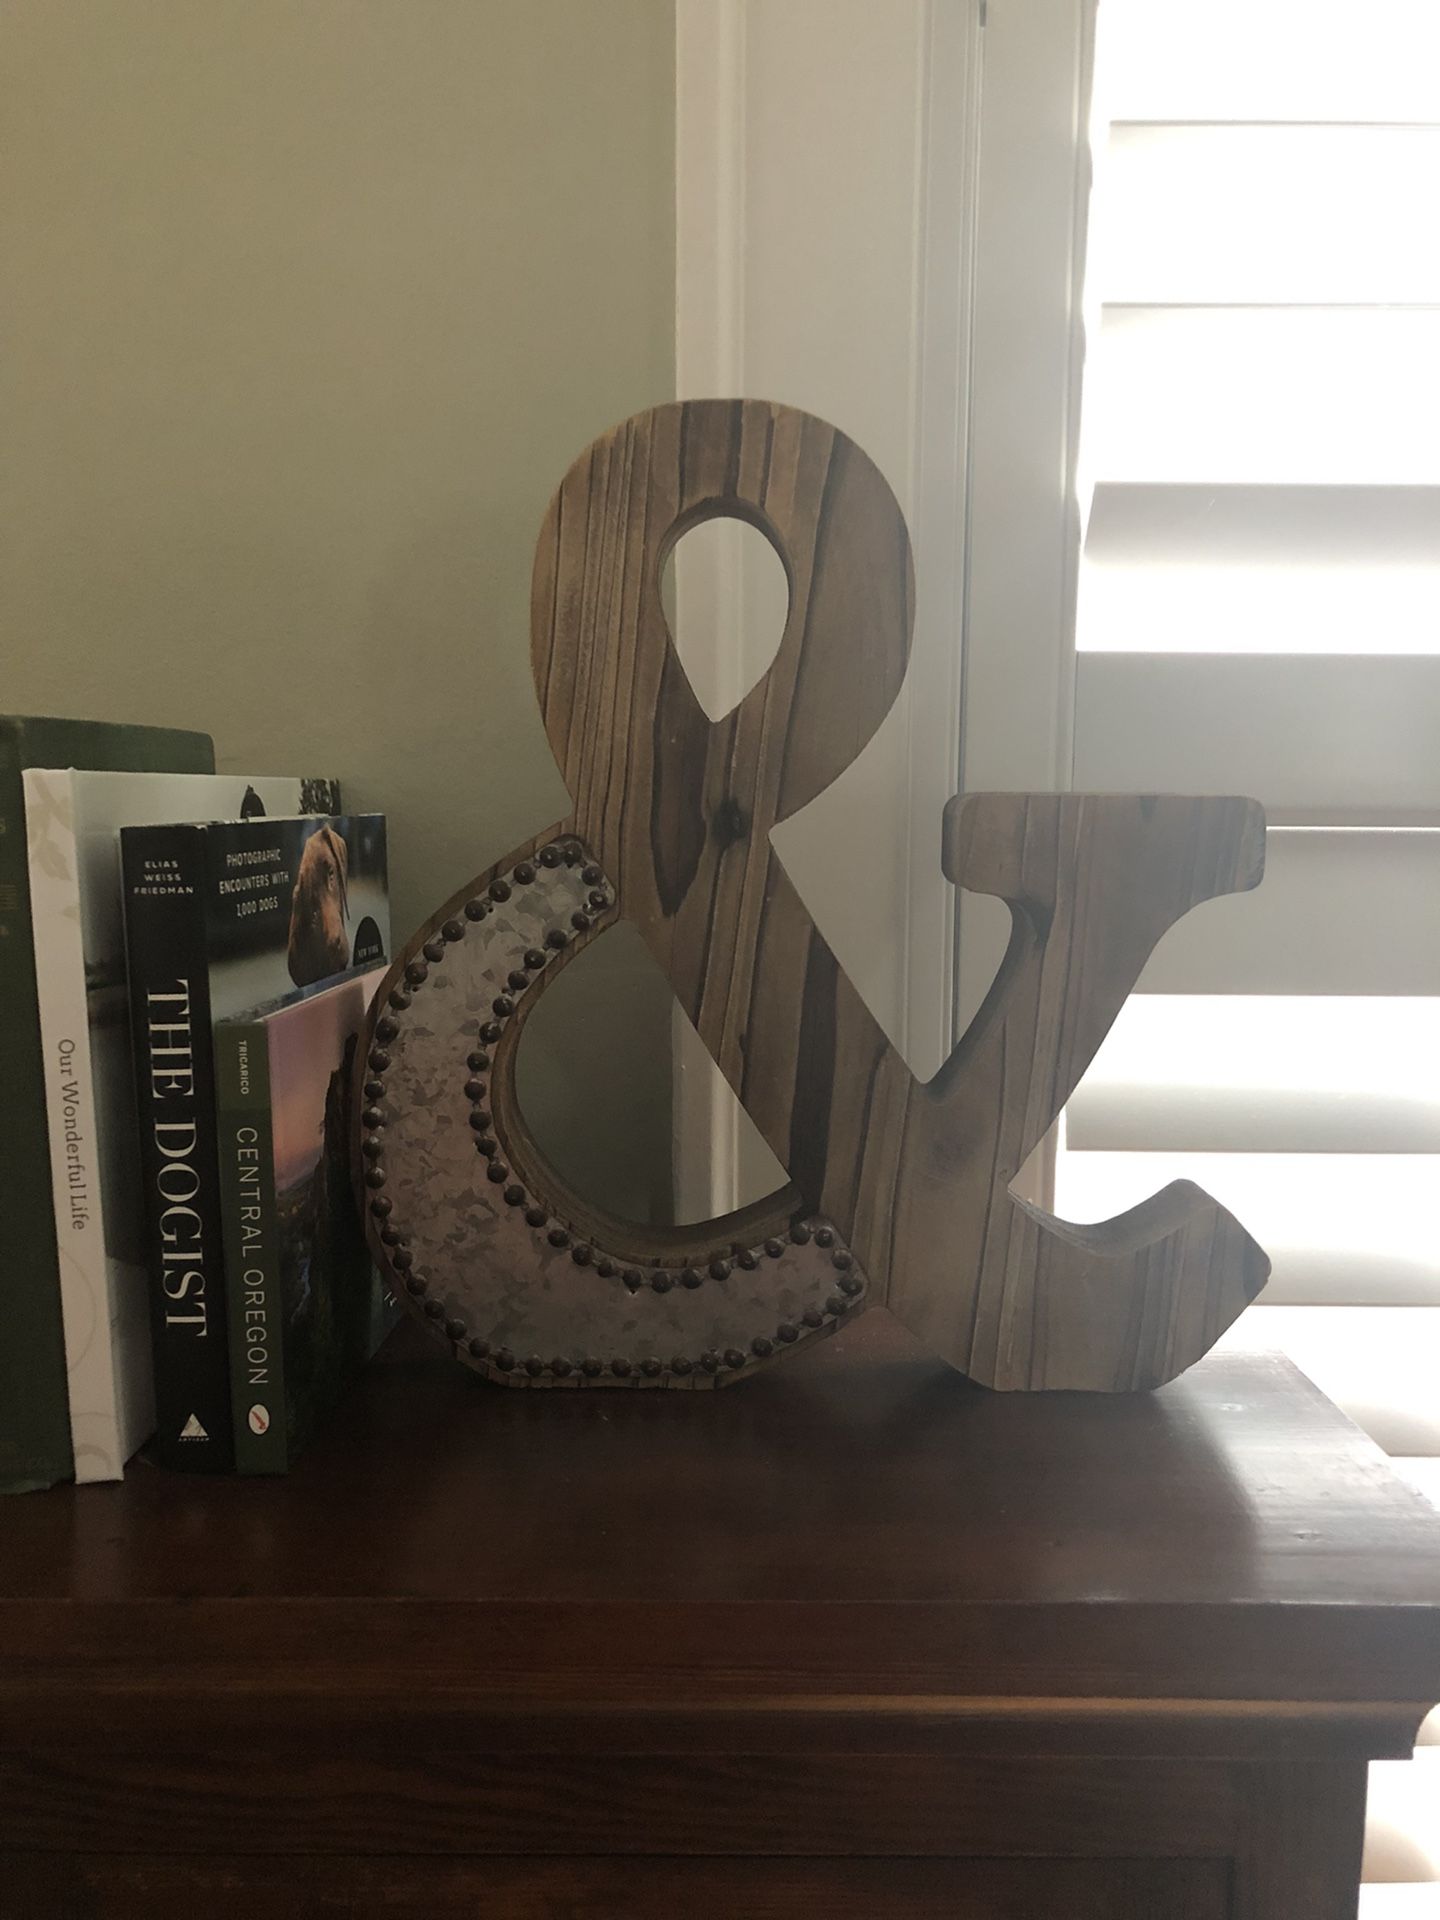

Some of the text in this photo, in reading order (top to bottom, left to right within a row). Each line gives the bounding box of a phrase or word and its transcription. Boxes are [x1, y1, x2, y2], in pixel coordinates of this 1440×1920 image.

[145, 860, 178, 868] ELIAS
[226, 849, 281, 867] PHOTOGRAPHIC
[144, 873, 182, 882] WEISS
[219, 871, 289, 894] ENCOUNTERS WITH
[134, 886, 194, 894] FRIEDMAN
[236, 896, 278, 918] 1,000 DOGS
[239, 1040, 250, 1095] TRICARICO
[58, 1039, 90, 1230] Our Wonderful Life
[147, 979, 207, 1336] THE DOGIST
[236, 1127, 269, 1385] CENTRAL OREGON
